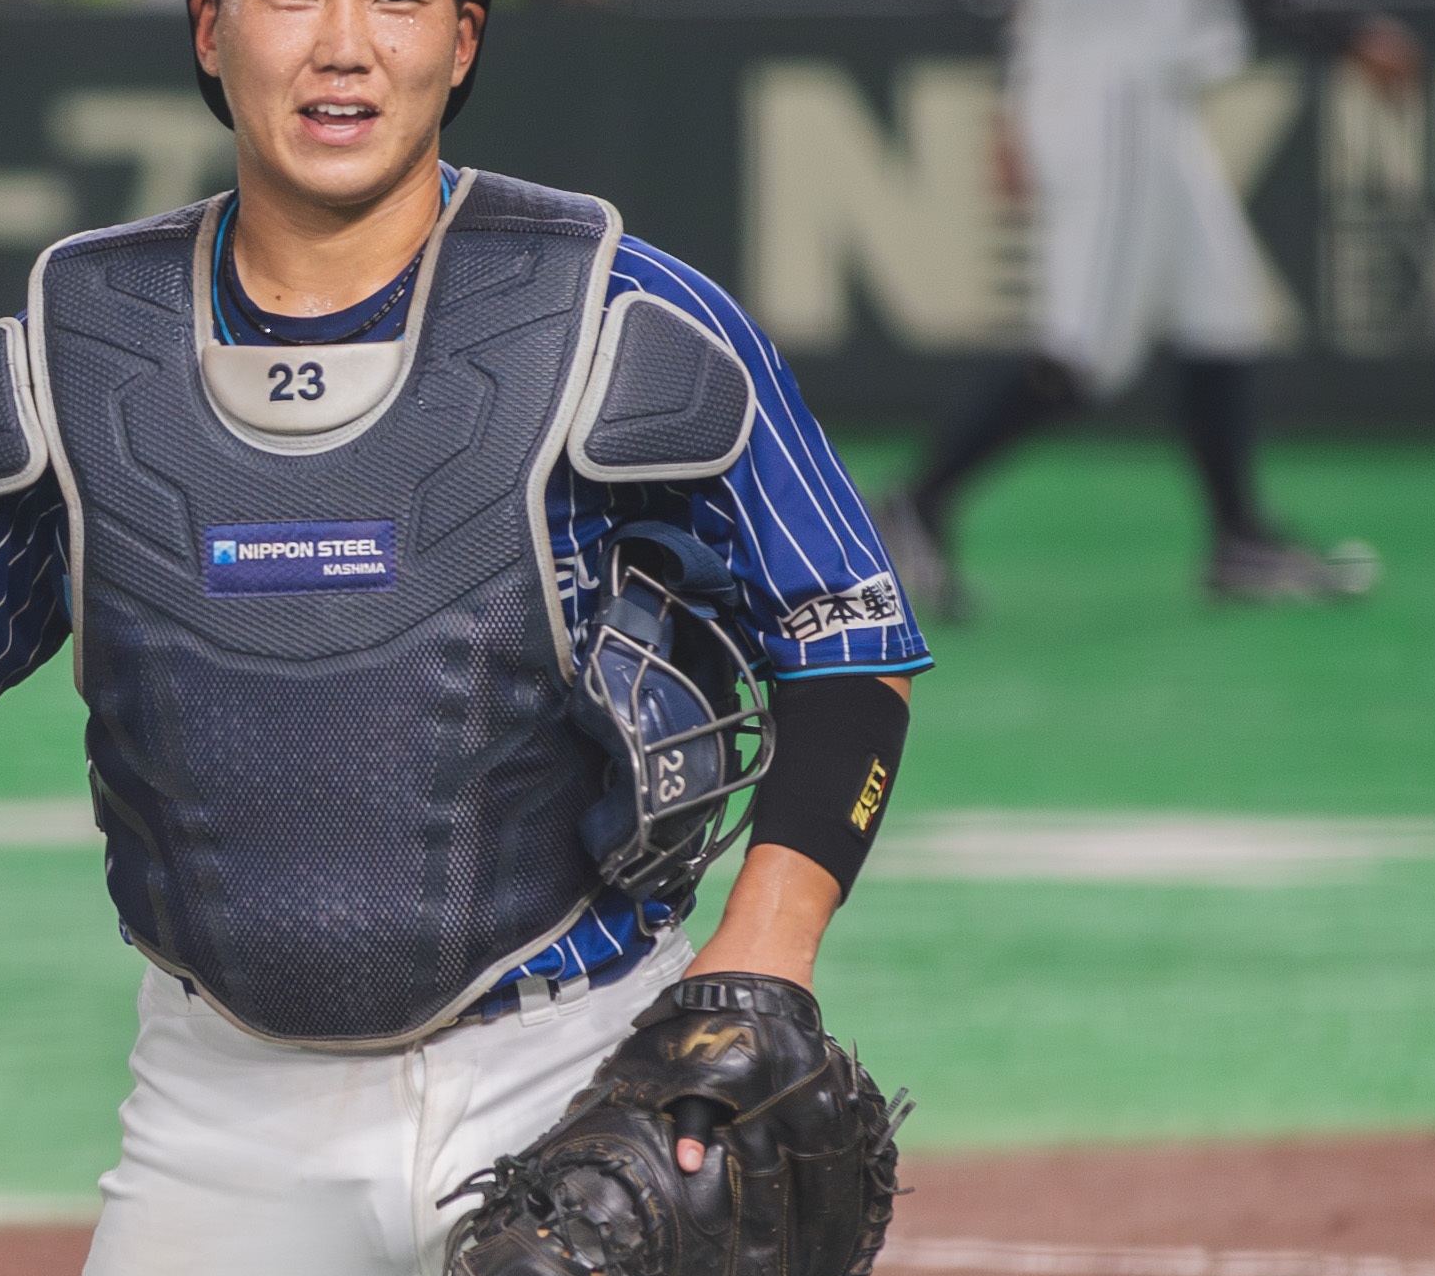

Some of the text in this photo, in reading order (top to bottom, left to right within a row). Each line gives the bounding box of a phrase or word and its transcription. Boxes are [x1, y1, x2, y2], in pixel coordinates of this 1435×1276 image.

[267, 361, 327, 402] 23
[238, 538, 383, 560] NIPPON STEEL
[322, 562, 387, 576] KASHIMA
[658, 749, 686, 803] 23
[851, 758, 886, 832] ZETT
